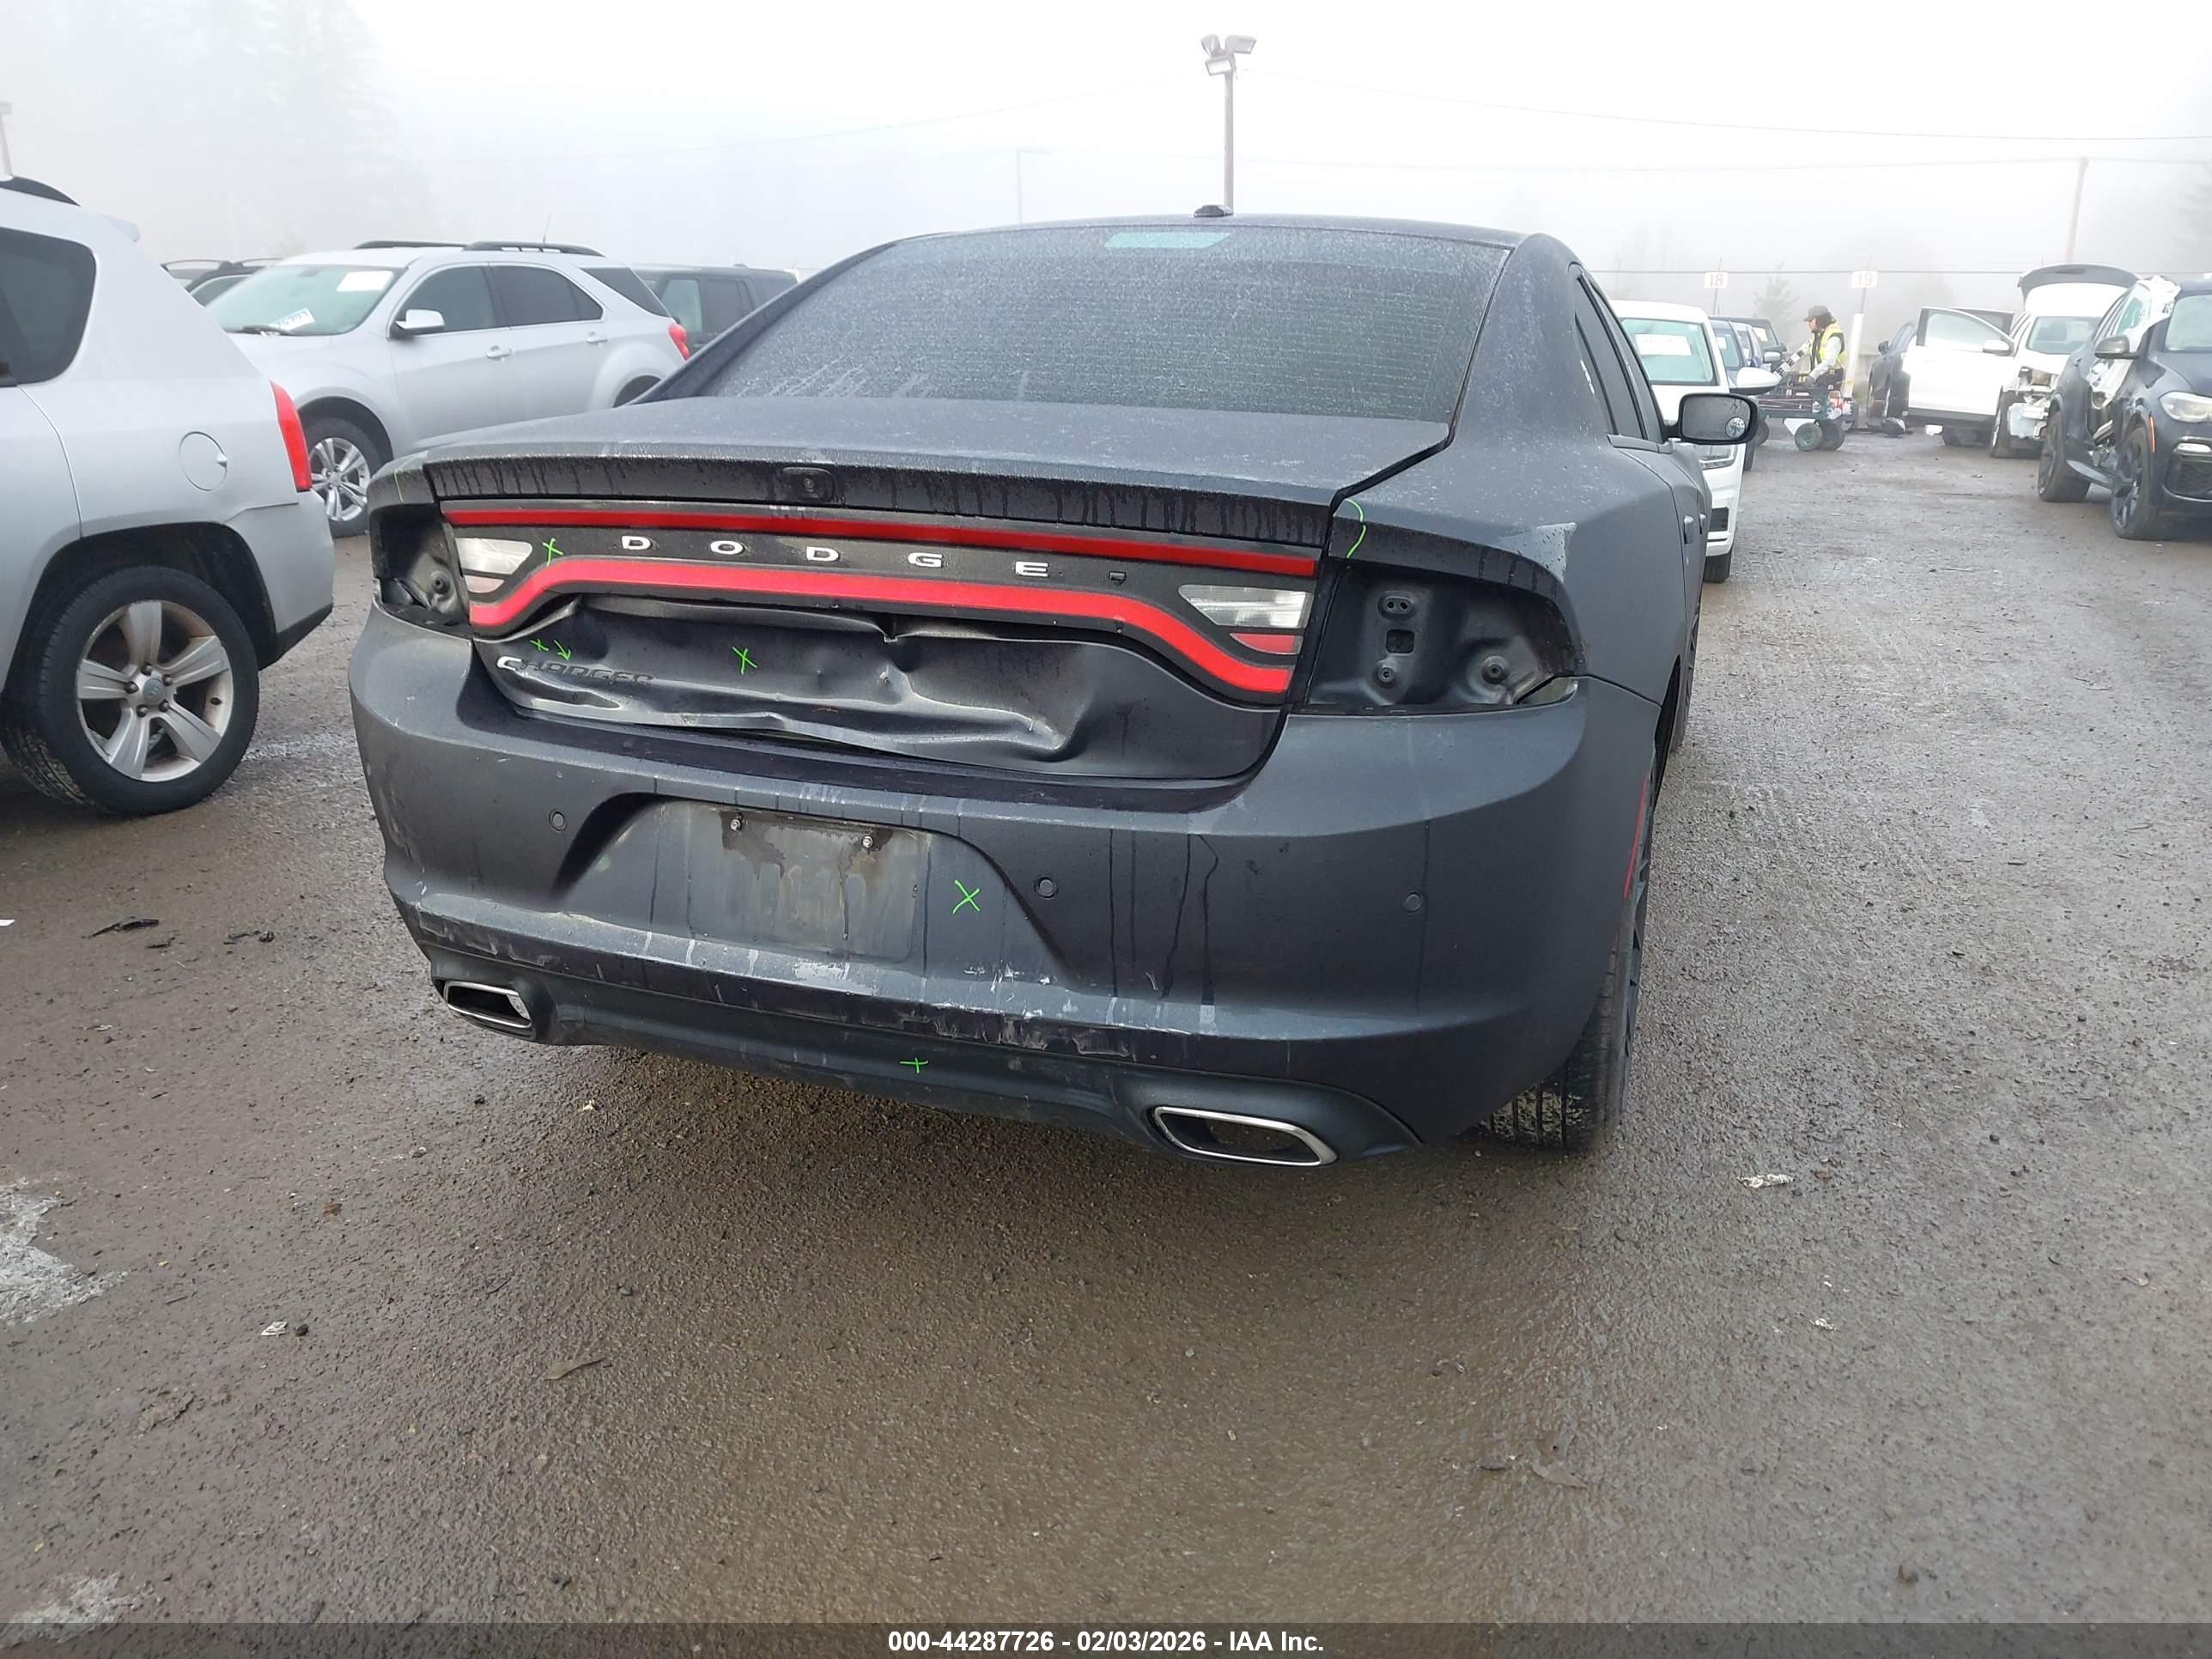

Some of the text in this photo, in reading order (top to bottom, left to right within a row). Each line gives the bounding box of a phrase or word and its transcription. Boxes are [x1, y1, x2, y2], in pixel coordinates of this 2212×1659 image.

[1709, 273, 1724, 288] 18
[1857, 271, 1874, 287] 19
[621, 535, 1048, 578] DODGE
